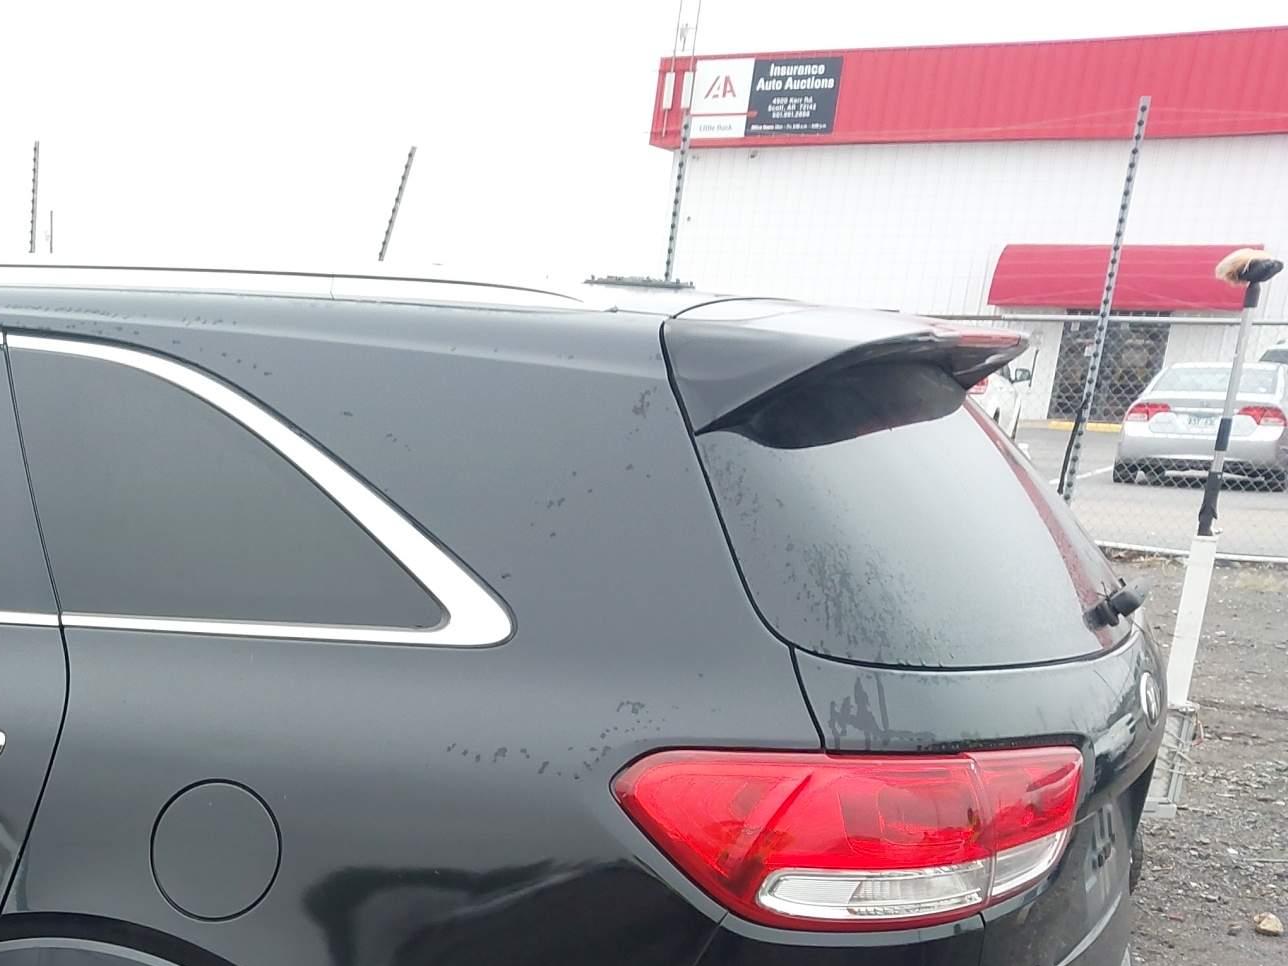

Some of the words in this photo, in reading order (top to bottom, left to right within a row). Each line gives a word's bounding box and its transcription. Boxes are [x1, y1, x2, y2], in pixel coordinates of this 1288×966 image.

[770, 62, 825, 76] Insurance
[756, 78, 782, 91] Auto
[784, 76, 834, 90] Auctions
